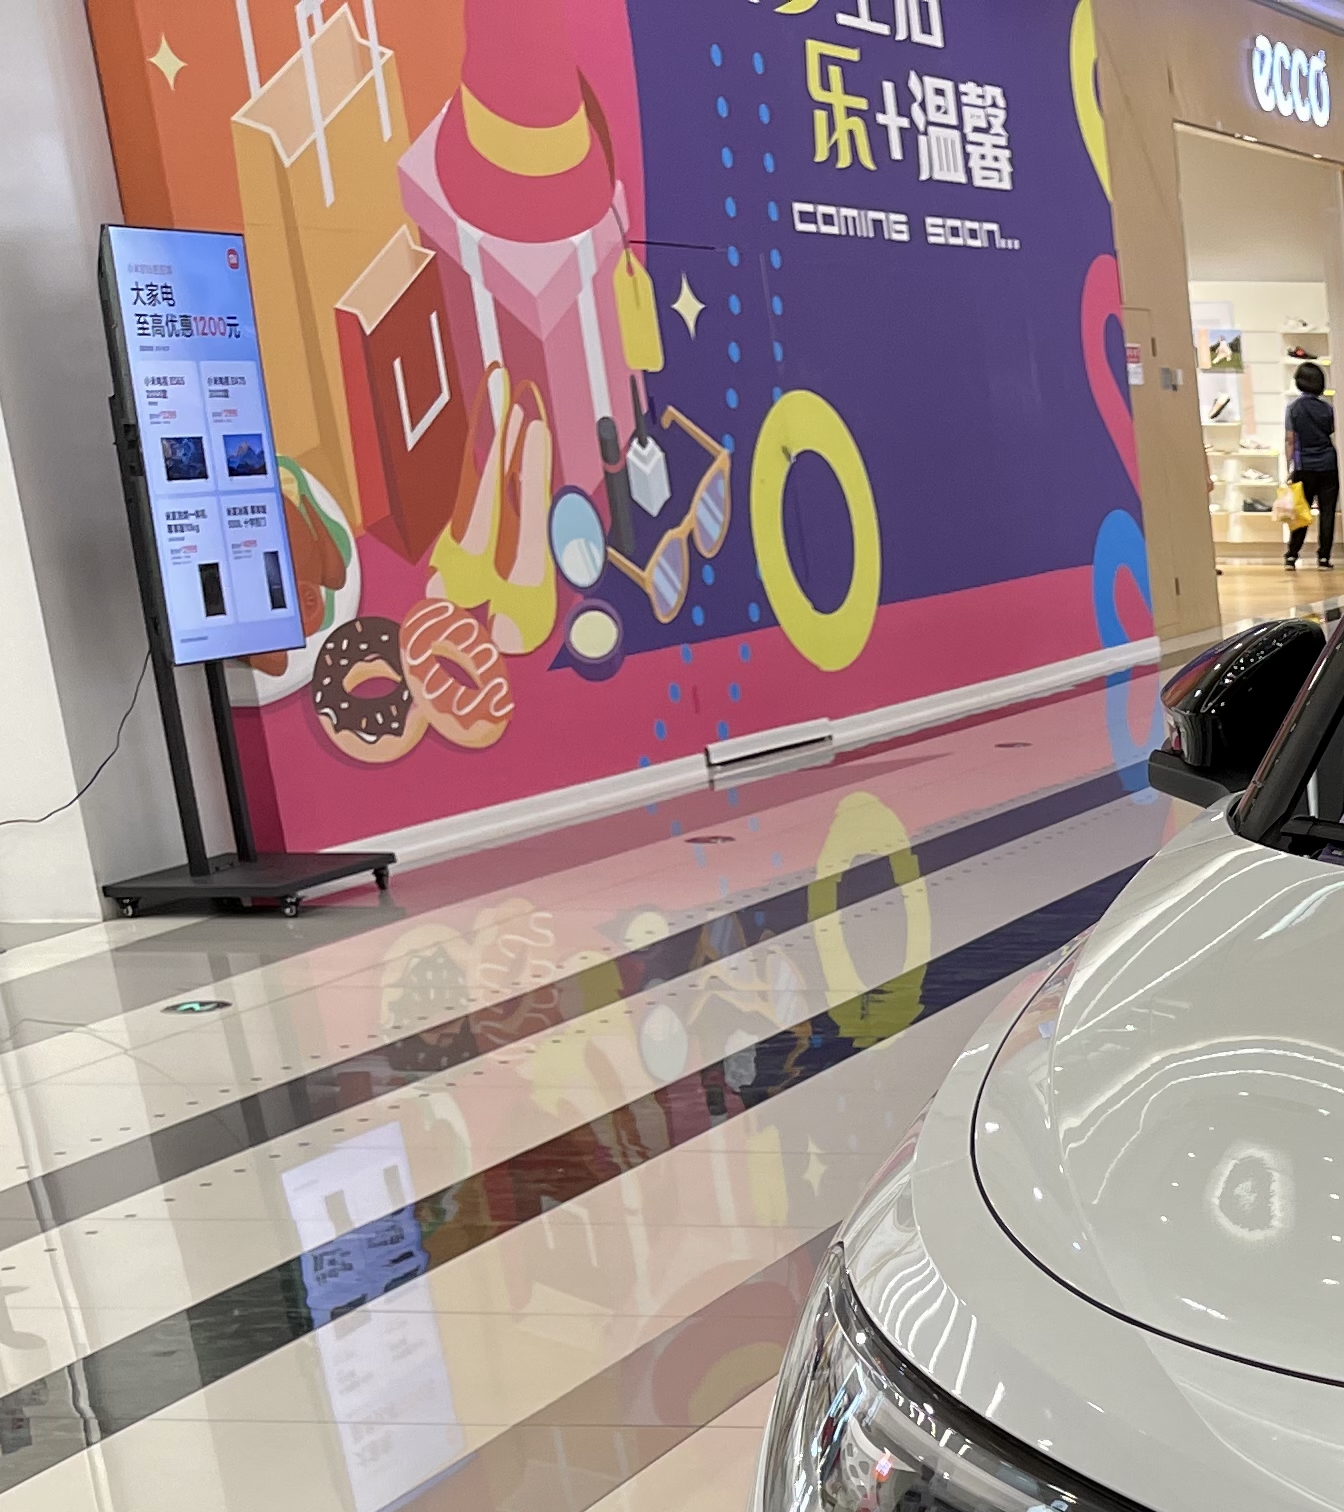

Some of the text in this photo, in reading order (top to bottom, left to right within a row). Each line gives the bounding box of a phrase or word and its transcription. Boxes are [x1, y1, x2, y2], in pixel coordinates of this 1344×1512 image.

[1253, 34, 1330, 127] ecco
[130, 281, 176, 307] 大家电
[134, 313, 241, 339] 至高优惠1200元
